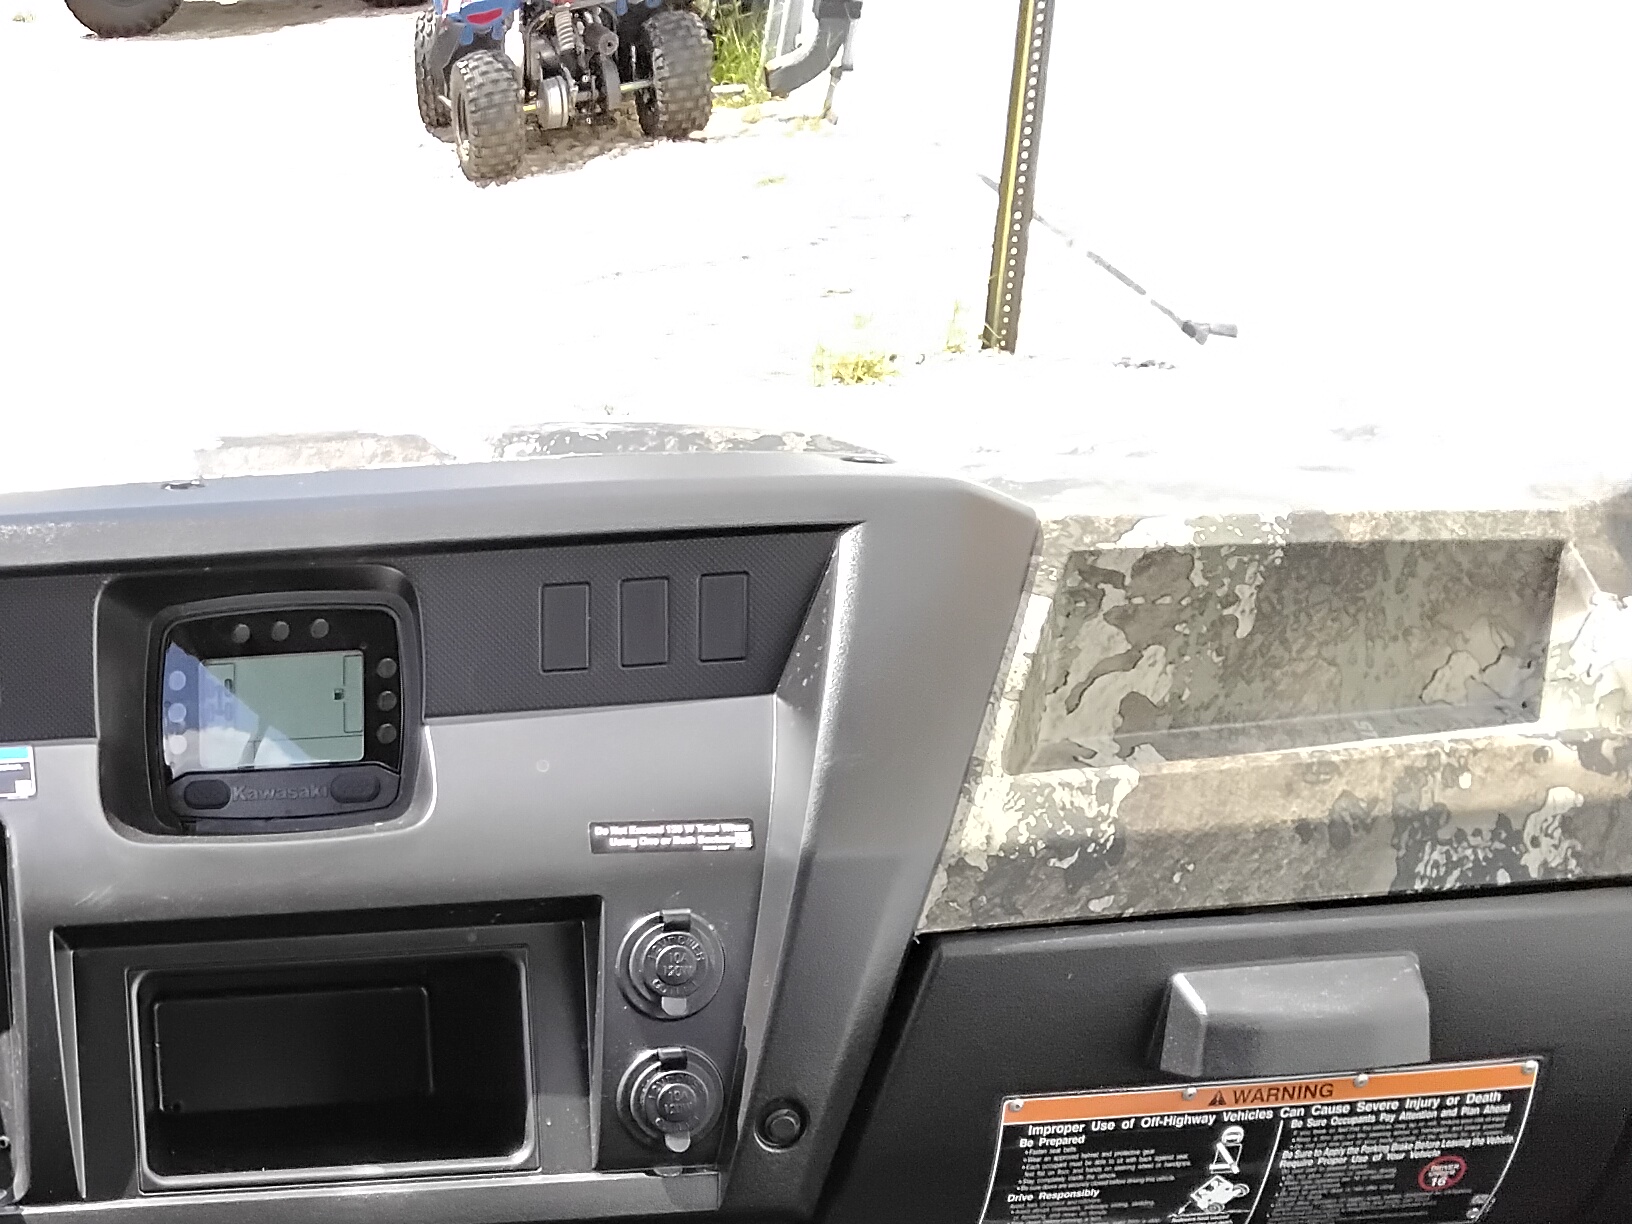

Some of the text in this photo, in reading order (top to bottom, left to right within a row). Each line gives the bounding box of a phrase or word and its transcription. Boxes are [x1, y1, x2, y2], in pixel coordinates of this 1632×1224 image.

[231, 784, 329, 801] Kawasaki
[1233, 1083, 1334, 1104] WARNING
[1028, 1090, 1501, 1137] Improper Use of Off-Highway Vehicles Can Cause Severe Injury or Death
[1290, 1103, 1510, 1128] Be Sure Occupants Pay Attention and Plan Ahead
[1019, 1134, 1084, 1149] Be Prepared
[1351, 1153, 1368, 1162] Use
[1372, 1153, 1382, 1162] of
[1431, 1177, 1448, 1187] 16
[1007, 1188, 1099, 1203] Drive Responsibly
